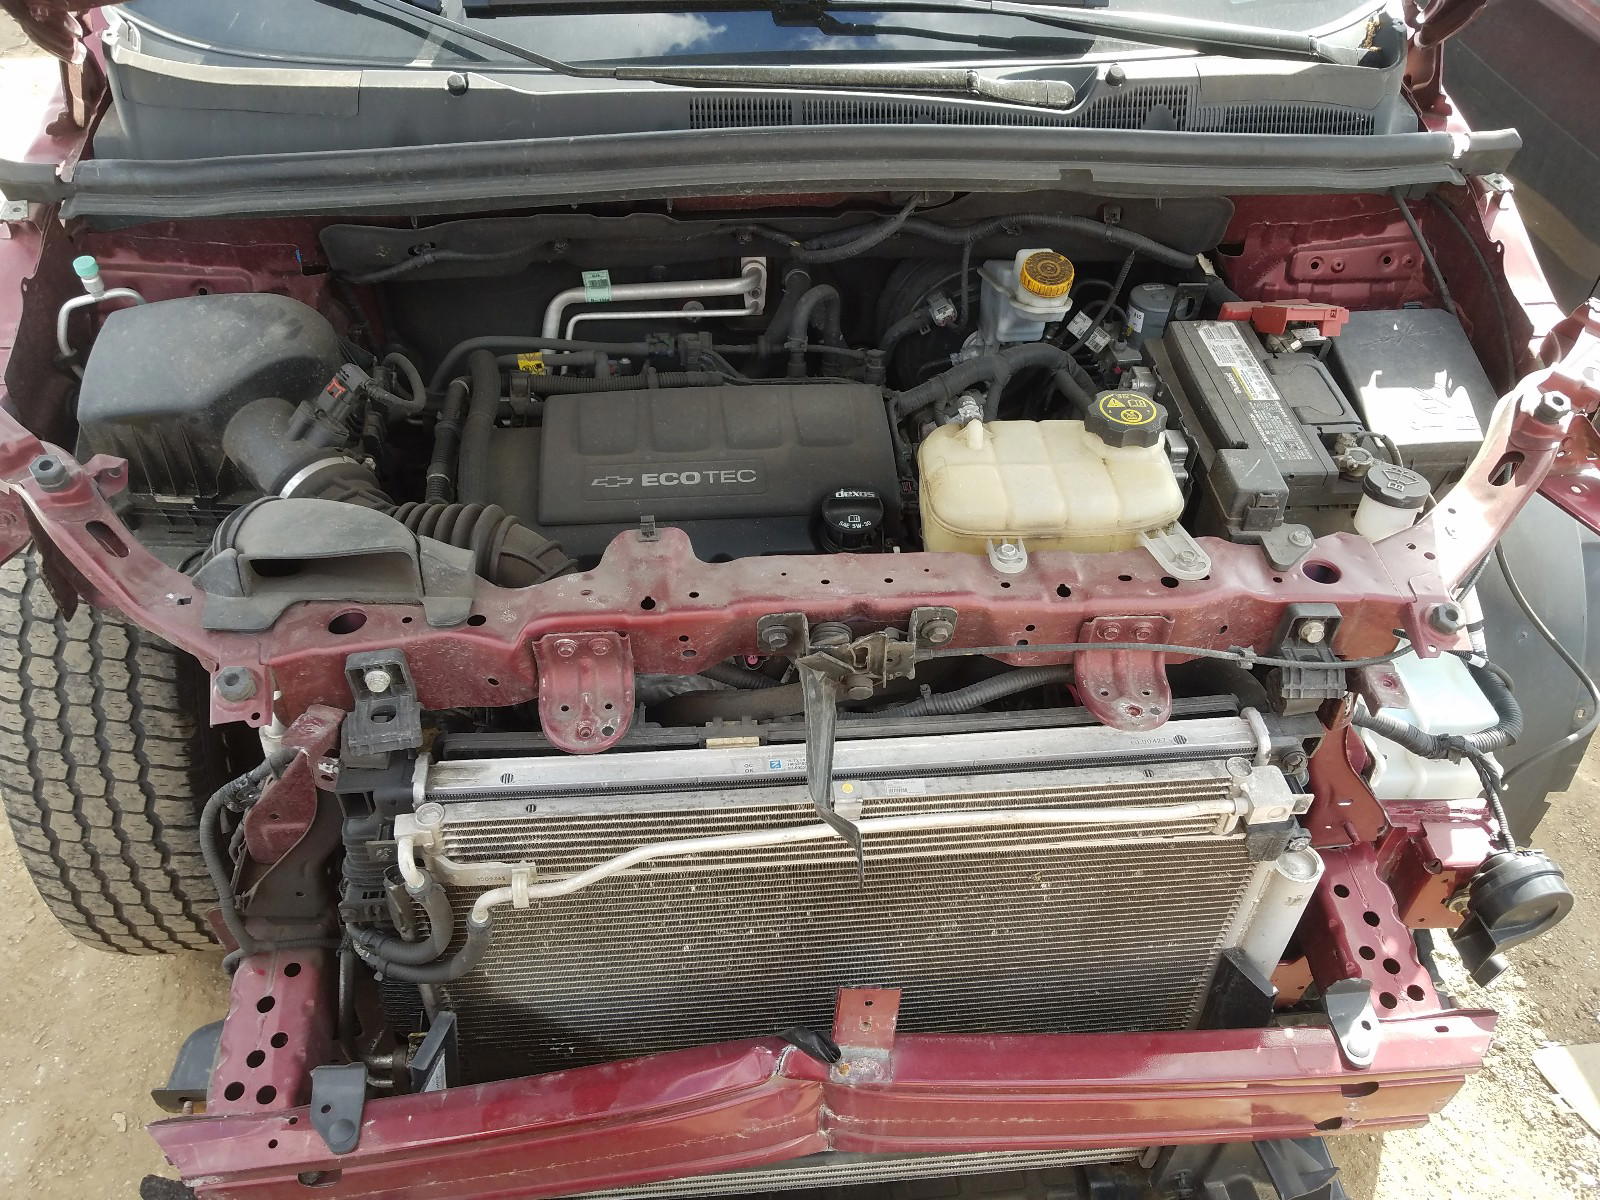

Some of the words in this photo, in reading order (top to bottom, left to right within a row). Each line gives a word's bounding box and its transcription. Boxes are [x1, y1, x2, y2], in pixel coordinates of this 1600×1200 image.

[641, 469, 757, 487] ECOTEC
[835, 488, 876, 498] dexos
[838, 520, 850, 529] SAE
